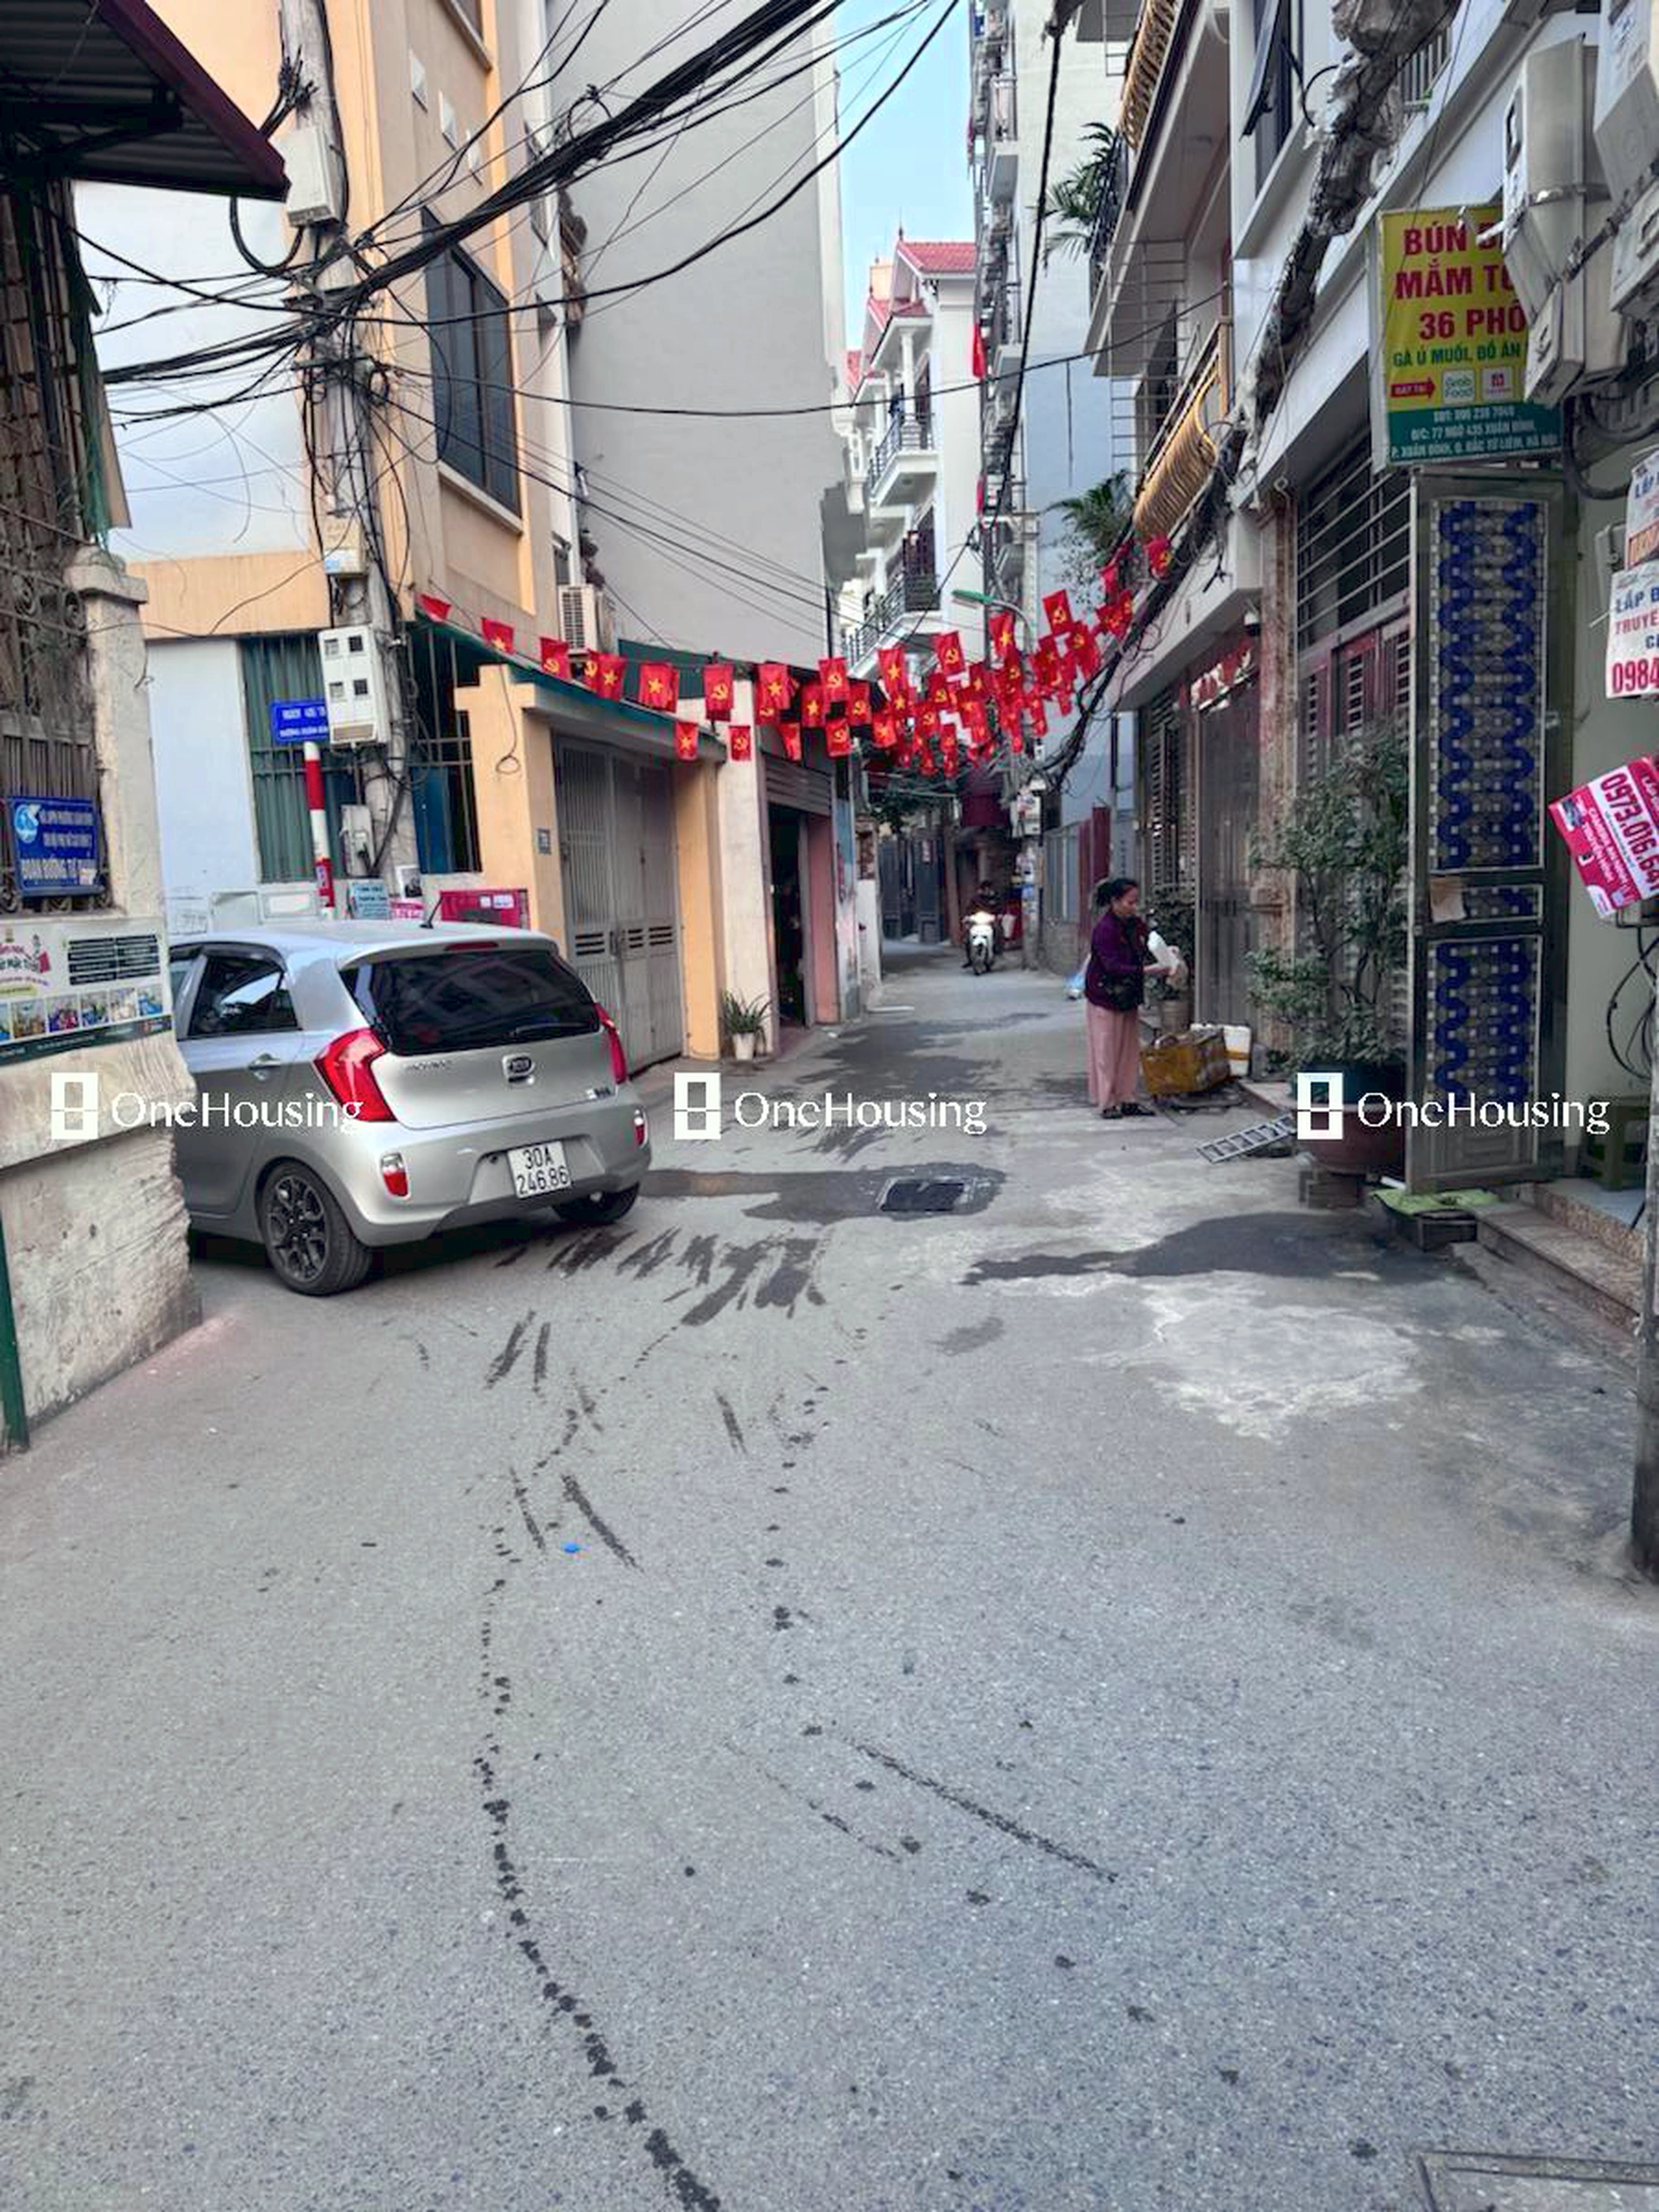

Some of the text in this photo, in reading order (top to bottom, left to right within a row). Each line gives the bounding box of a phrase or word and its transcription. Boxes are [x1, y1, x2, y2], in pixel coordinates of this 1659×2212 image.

[1404, 220, 1467, 256] BÚN
[1396, 258, 1472, 300] MẮM
[1419, 311, 1455, 339] 36
[522, 1146, 554, 1169] 30A
[516, 1166, 570, 1195] 246.86
